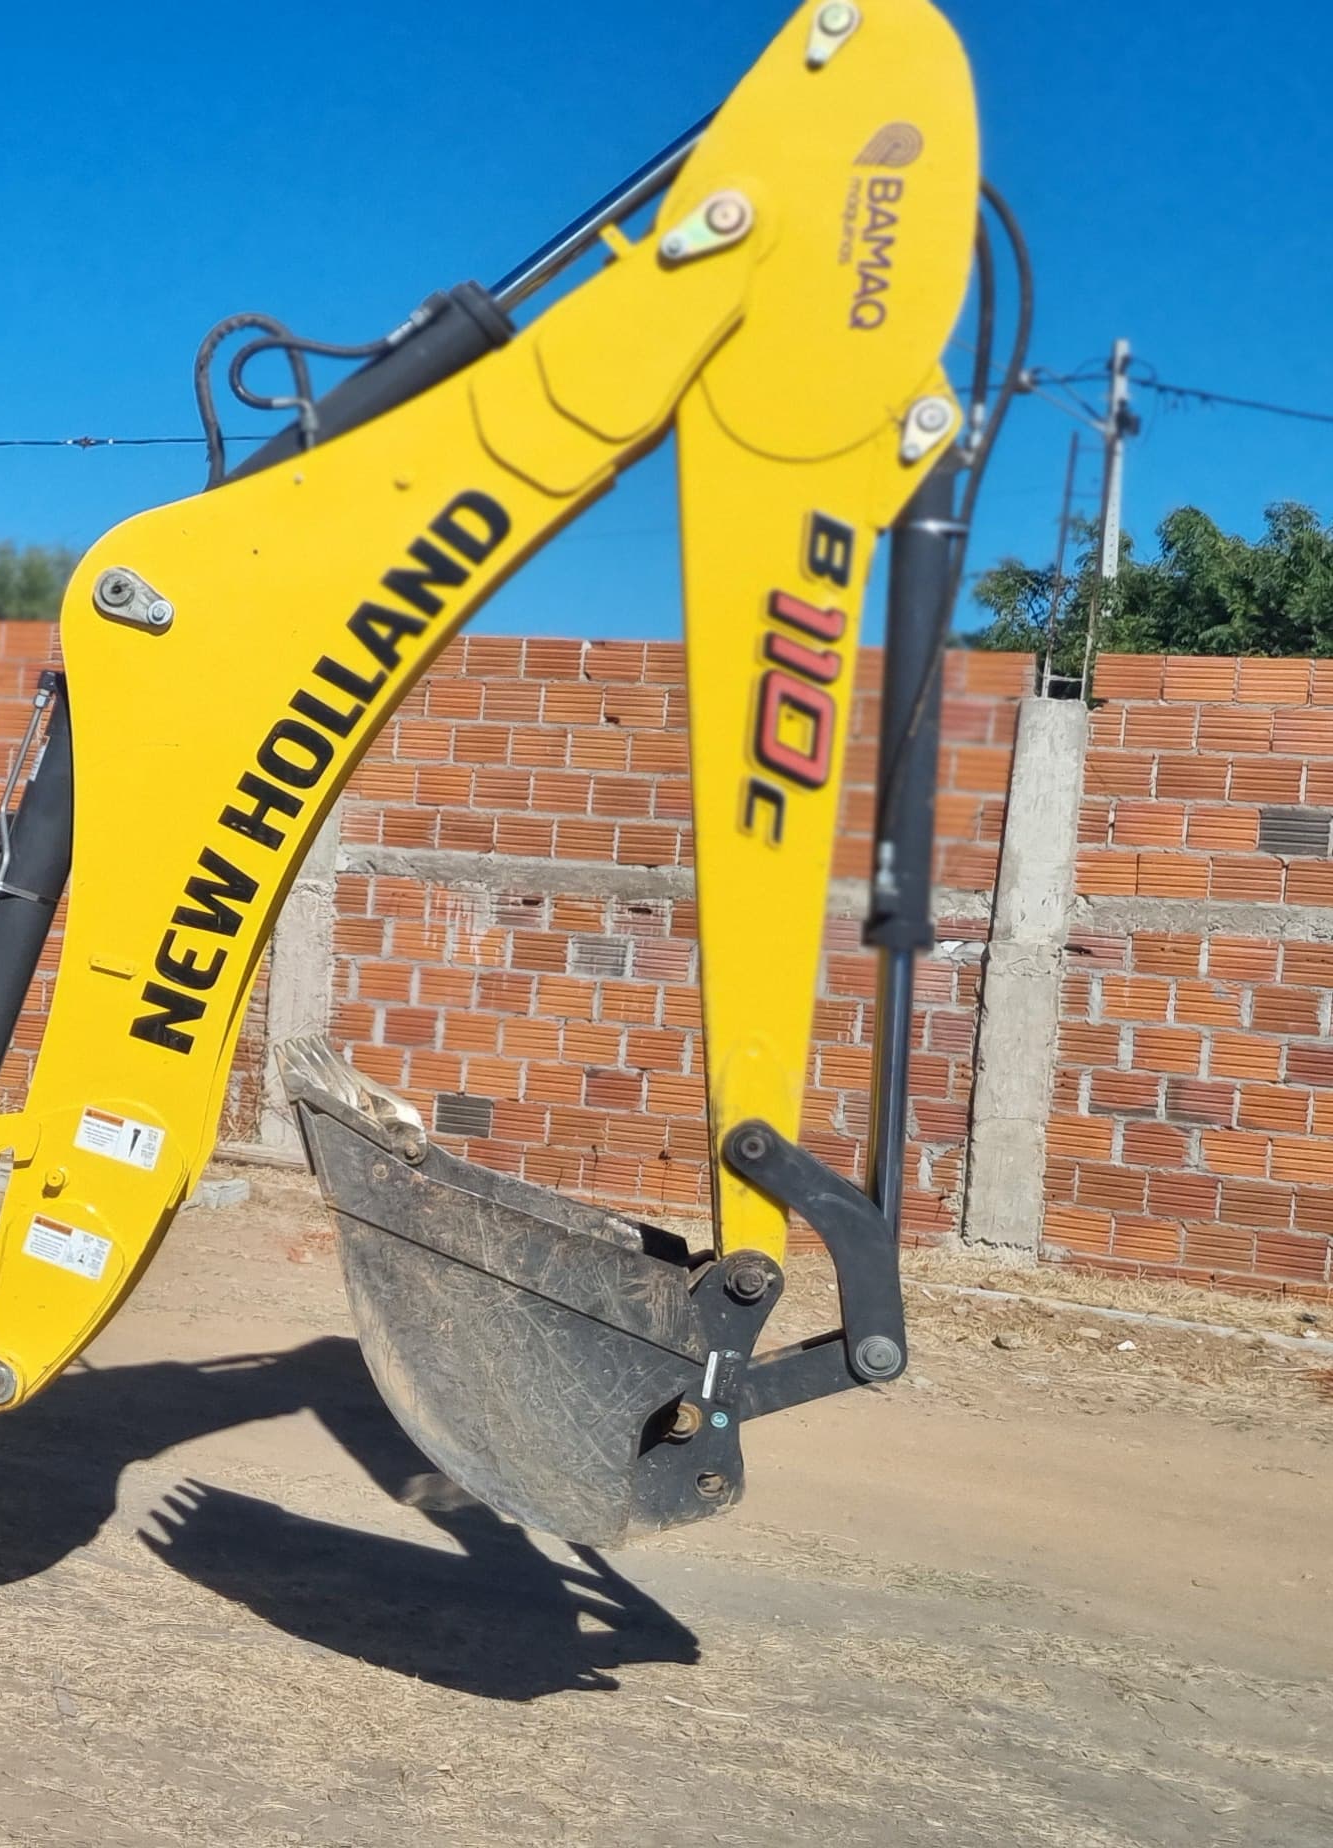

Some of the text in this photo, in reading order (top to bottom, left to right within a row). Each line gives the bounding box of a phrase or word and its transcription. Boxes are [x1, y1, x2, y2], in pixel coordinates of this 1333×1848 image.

[850, 177, 904, 330] BAMAQ
[129, 489, 512, 1055] NEW HOLLAND
